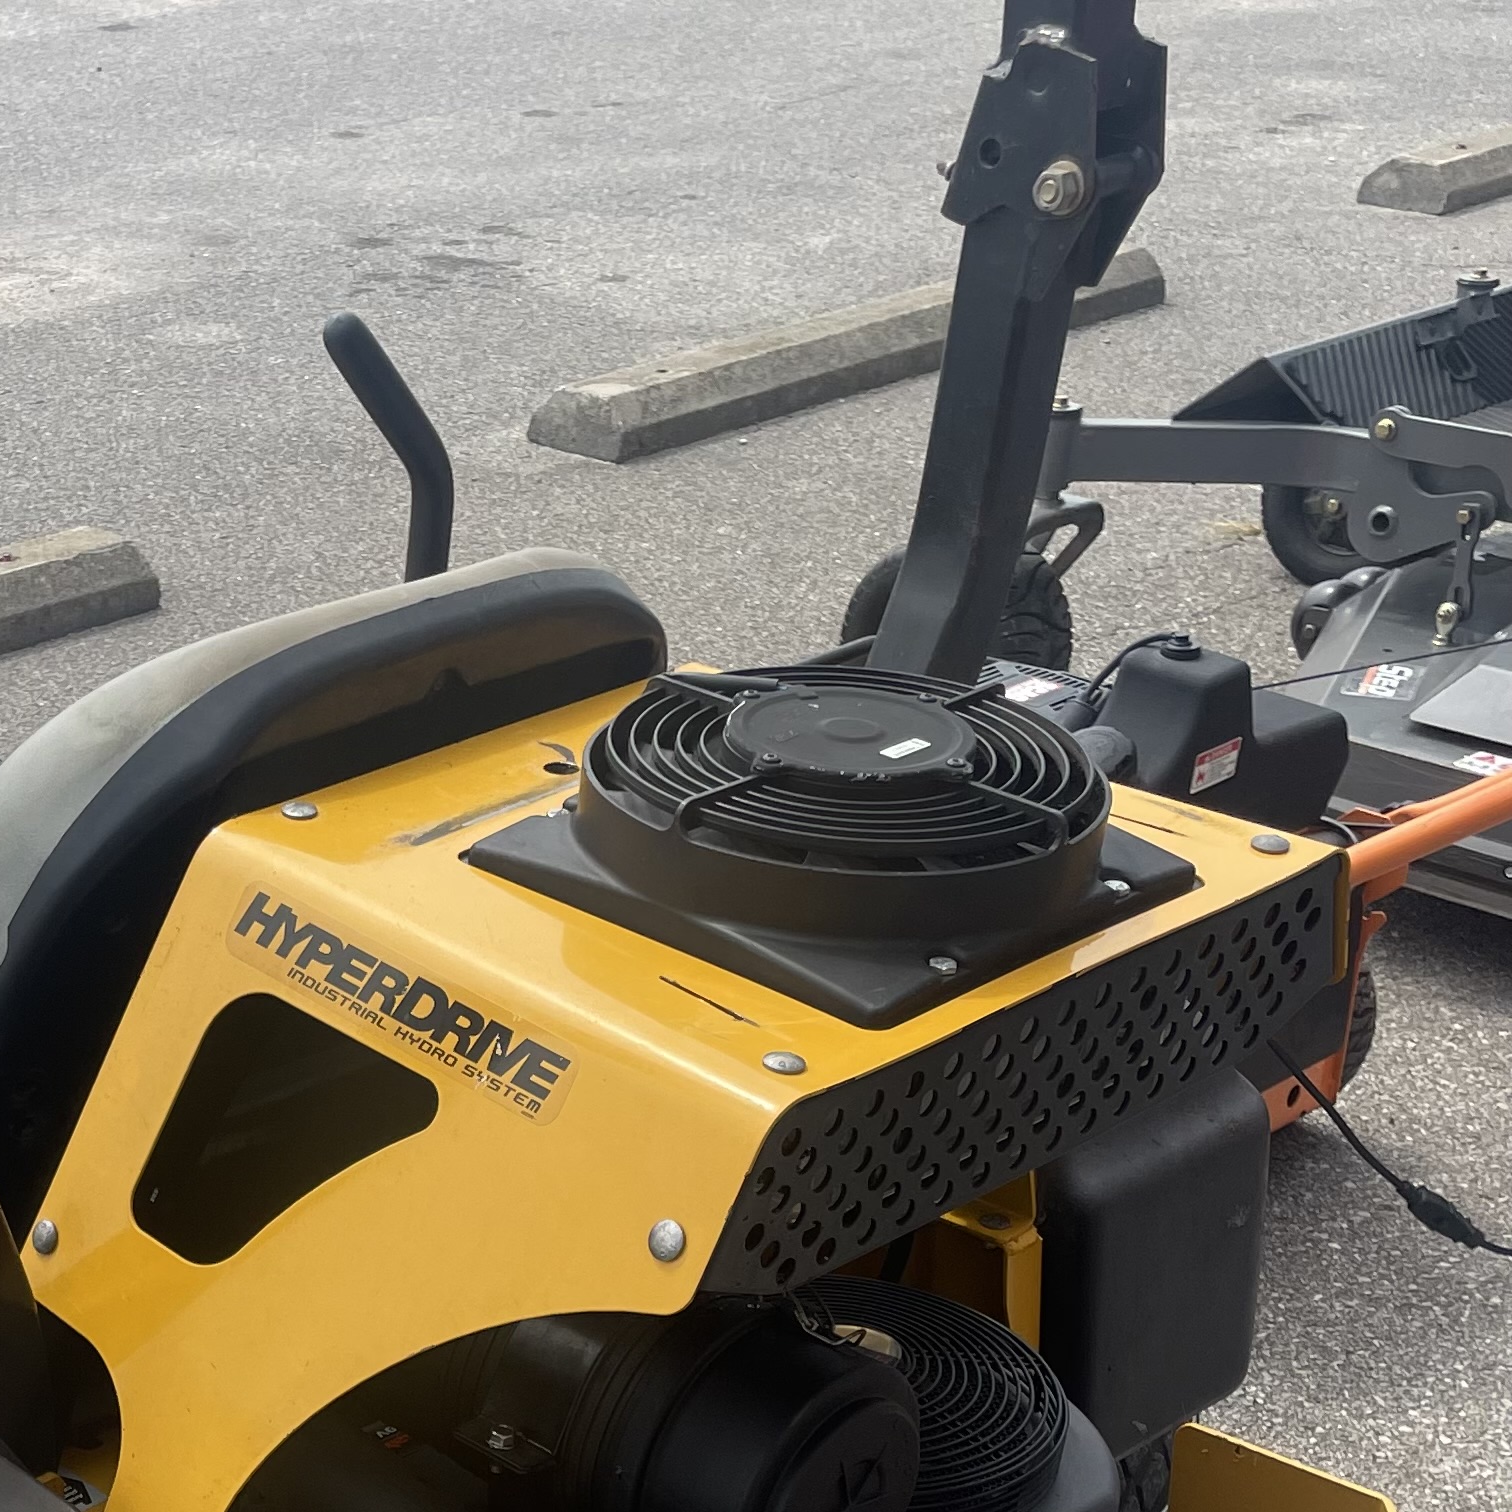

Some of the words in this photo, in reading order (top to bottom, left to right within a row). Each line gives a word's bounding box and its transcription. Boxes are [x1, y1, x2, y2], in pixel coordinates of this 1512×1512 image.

[234, 891, 571, 1100] HYPERDRIVE
[287, 967, 387, 1031] INDUSTRIAL
[394, 1027, 457, 1067] HYDRO
[462, 1064, 541, 1114] SYSTEM
